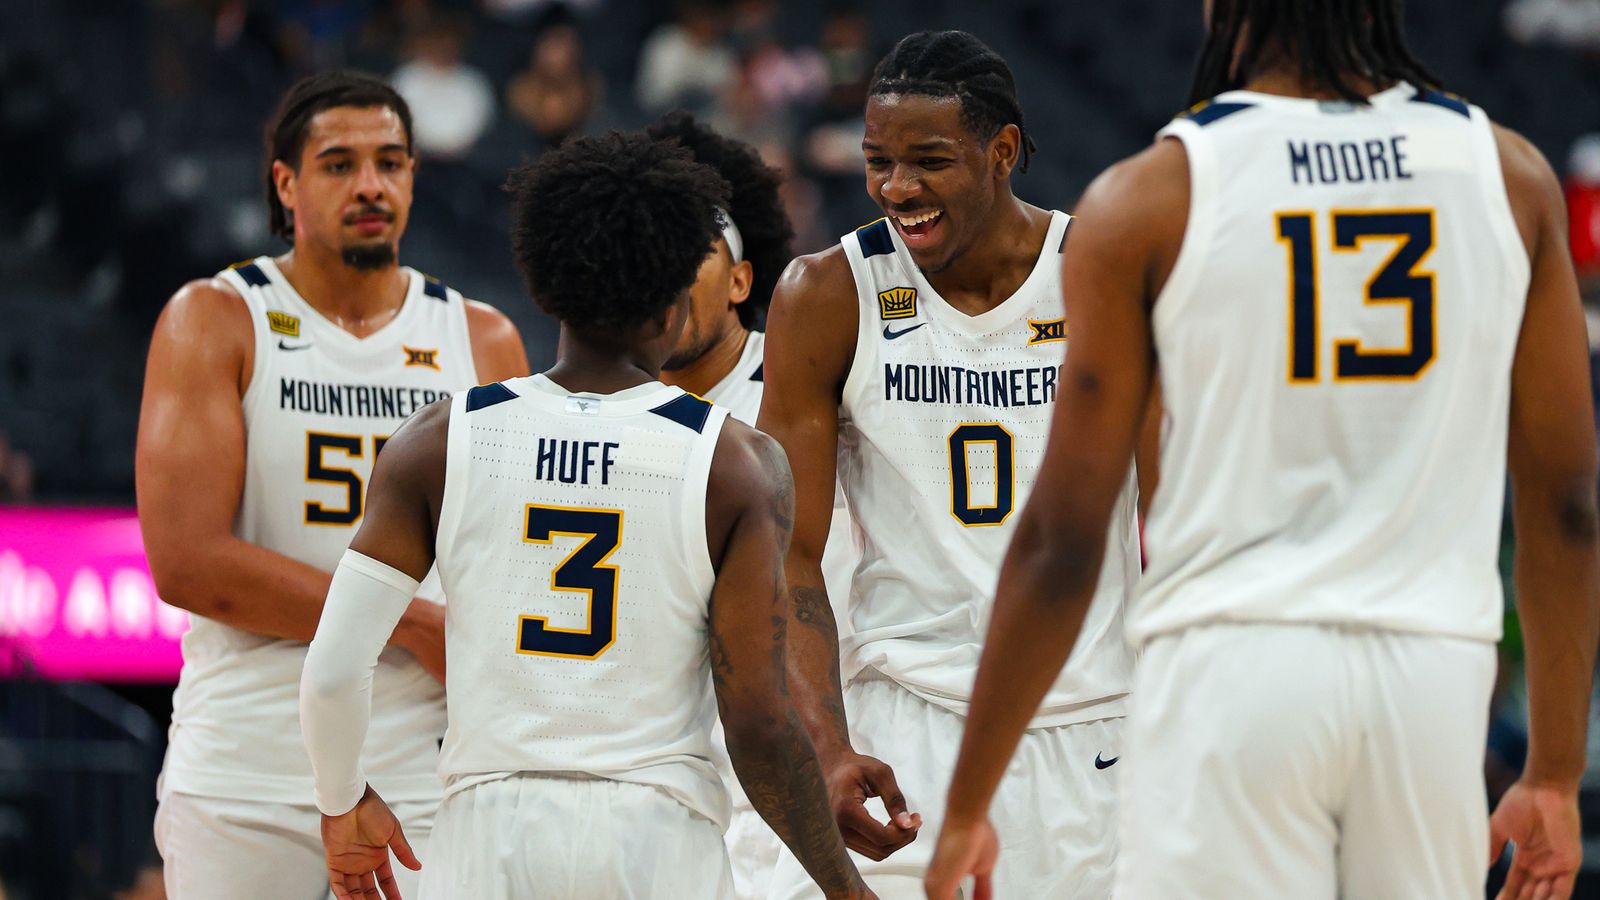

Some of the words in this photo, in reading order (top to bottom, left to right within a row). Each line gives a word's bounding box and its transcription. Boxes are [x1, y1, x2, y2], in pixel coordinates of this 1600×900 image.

[1287, 136, 1413, 183] MOORE
[1274, 208, 1438, 384] 13
[884, 363, 1065, 408] MOUNTAINEER
[304, 430, 391, 527] 5
[535, 438, 620, 485] HUFF
[947, 422, 1015, 527] 0
[515, 503, 624, 660] 3
